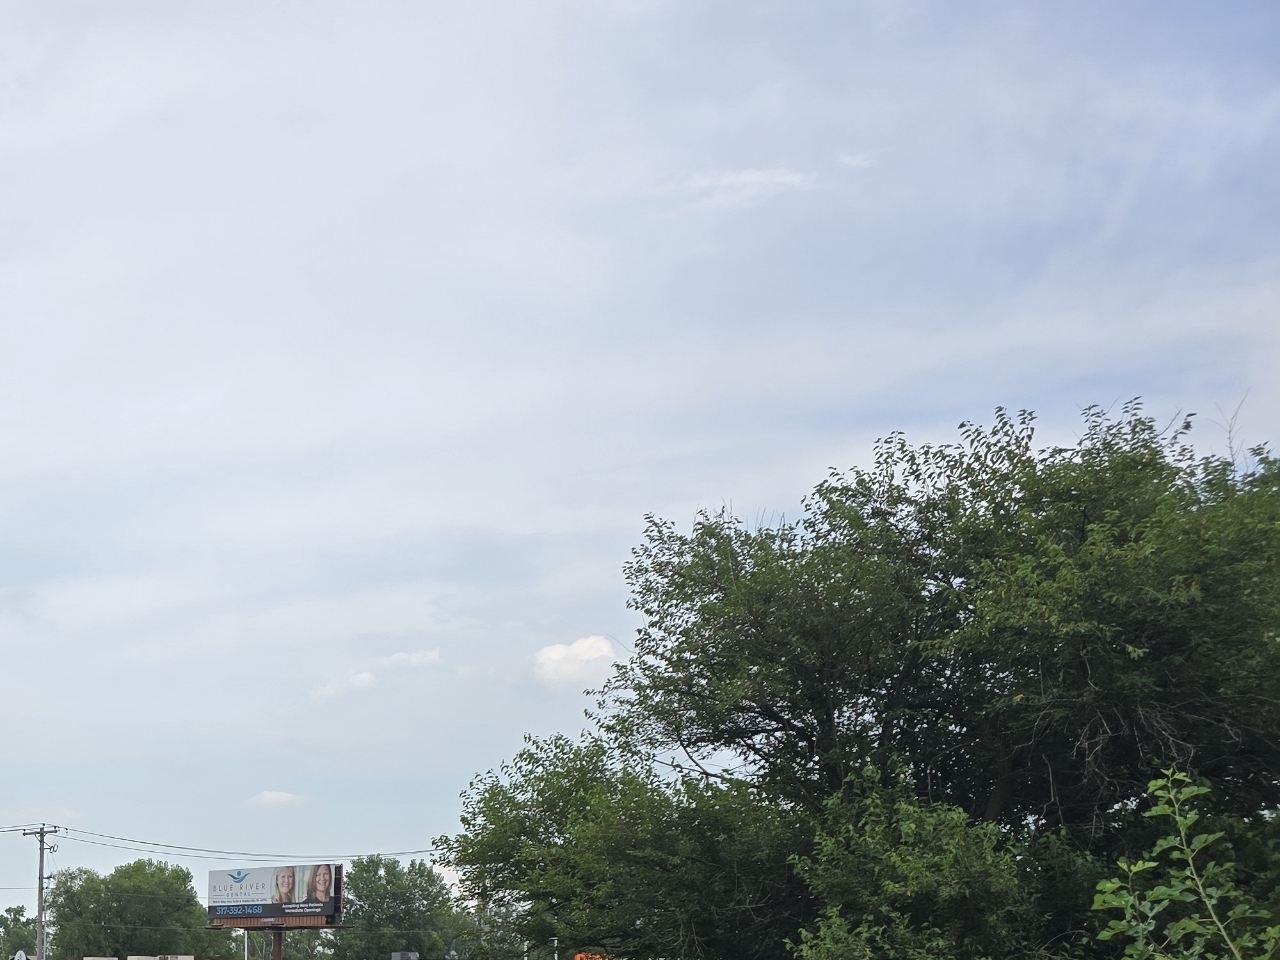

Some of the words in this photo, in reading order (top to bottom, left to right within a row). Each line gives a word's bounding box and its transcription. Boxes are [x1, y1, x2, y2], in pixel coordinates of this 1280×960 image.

[213, 884, 234, 892] BLUE
[240, 883, 266, 891] RIVER
[216, 905, 263, 915] 317-392-1468
